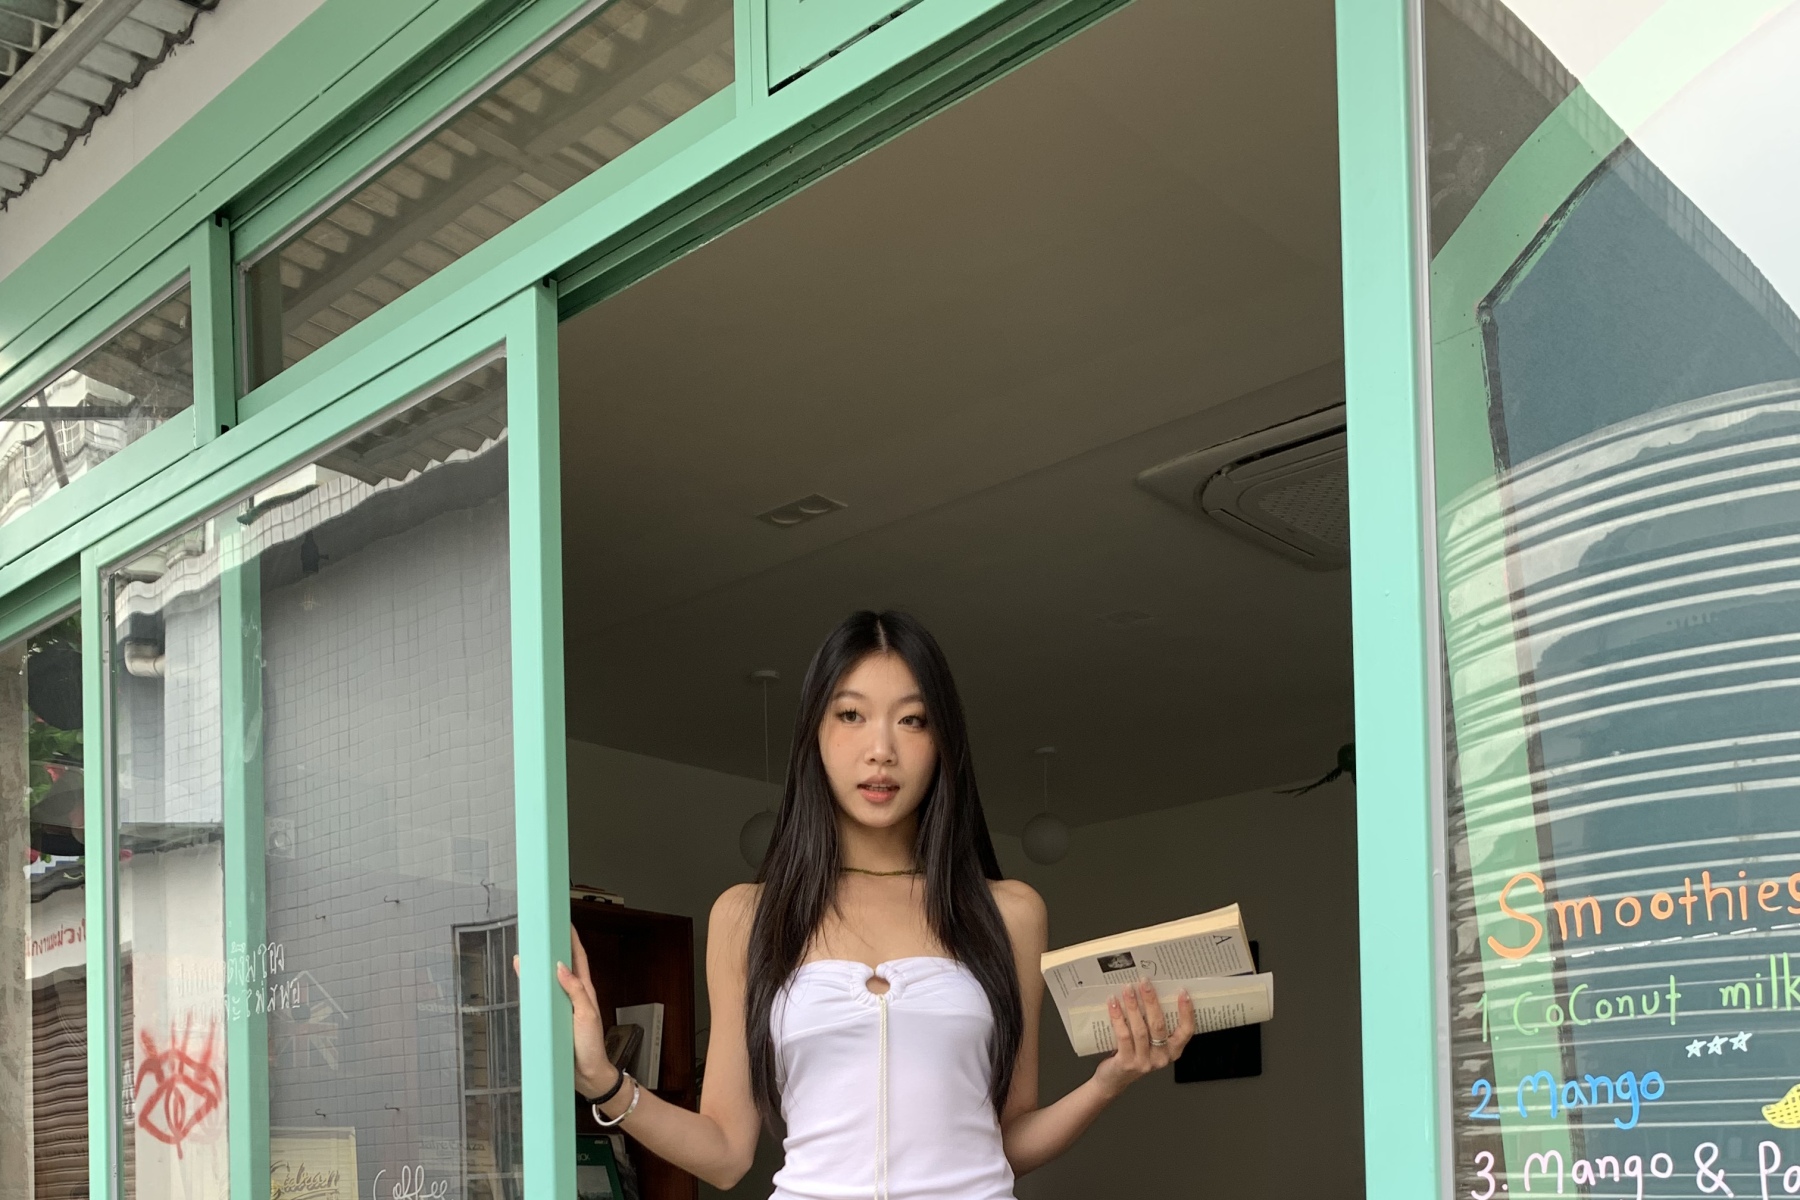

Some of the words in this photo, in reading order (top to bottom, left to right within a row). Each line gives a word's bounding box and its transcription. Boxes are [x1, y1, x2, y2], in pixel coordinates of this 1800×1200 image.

[1487, 870, 1800, 959] Smoothies
[1719, 951, 1800, 1011] milk
[1517, 1070, 1665, 1130] Mango
[1471, 1150, 1508, 1200] 3.
[1694, 1141, 1735, 1199] &
